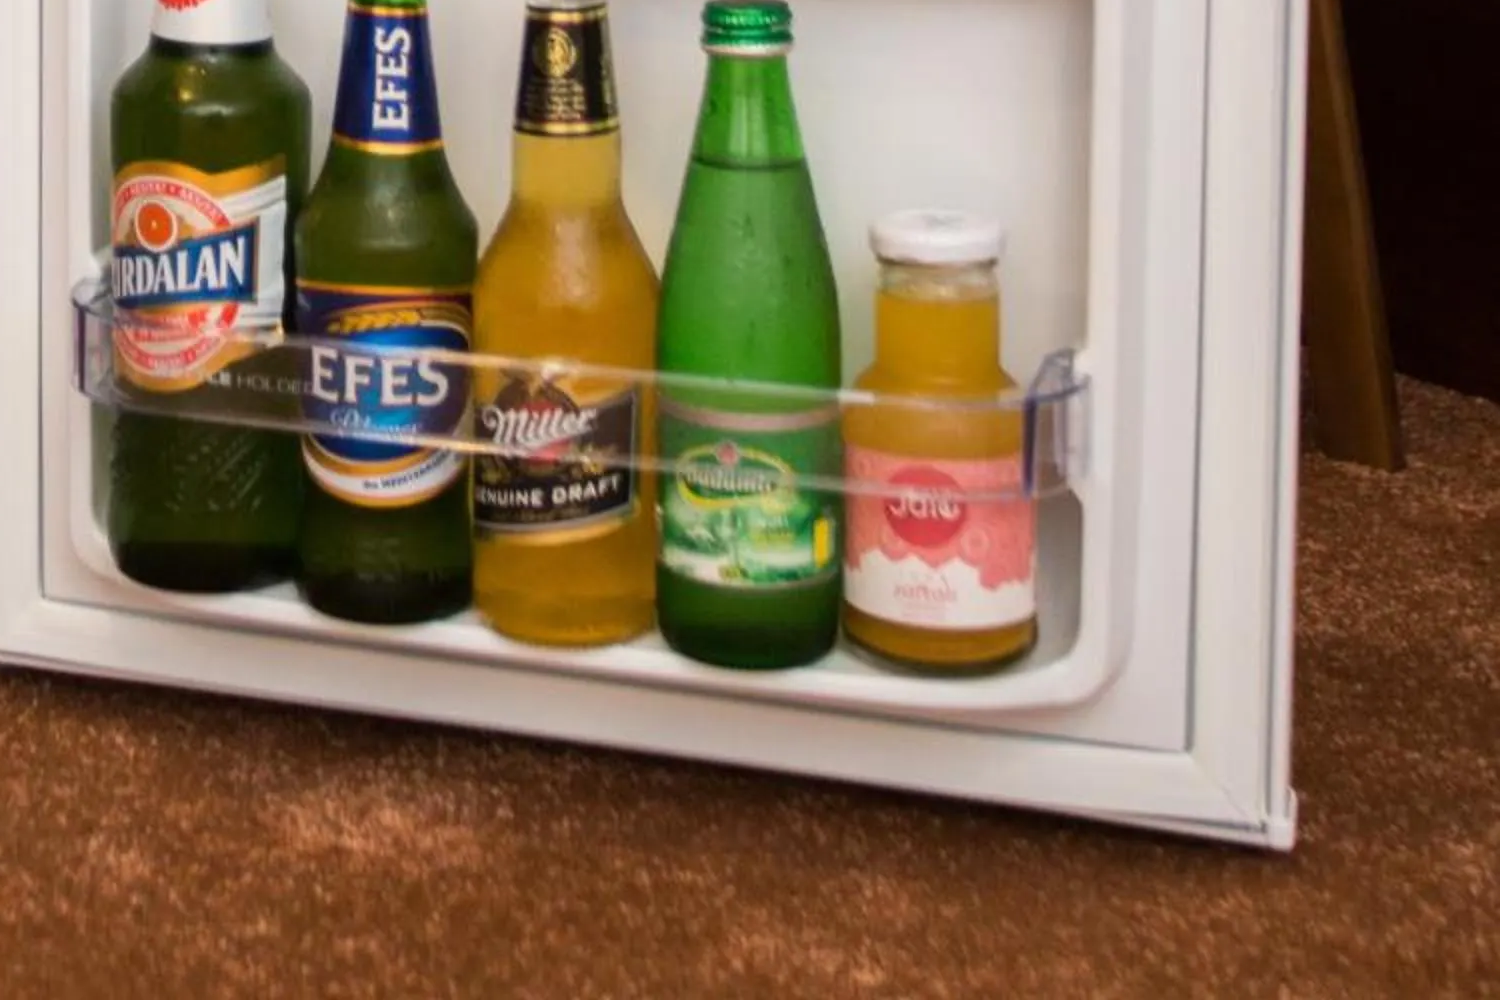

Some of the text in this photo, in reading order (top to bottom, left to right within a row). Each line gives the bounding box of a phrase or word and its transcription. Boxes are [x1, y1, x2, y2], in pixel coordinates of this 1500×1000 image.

[372, 25, 411, 131] EFES
[111, 235, 246, 299] IRDALAN
[311, 345, 449, 407] EFES
[483, 406, 598, 452] Miller
[551, 475, 620, 502] DRAFT
